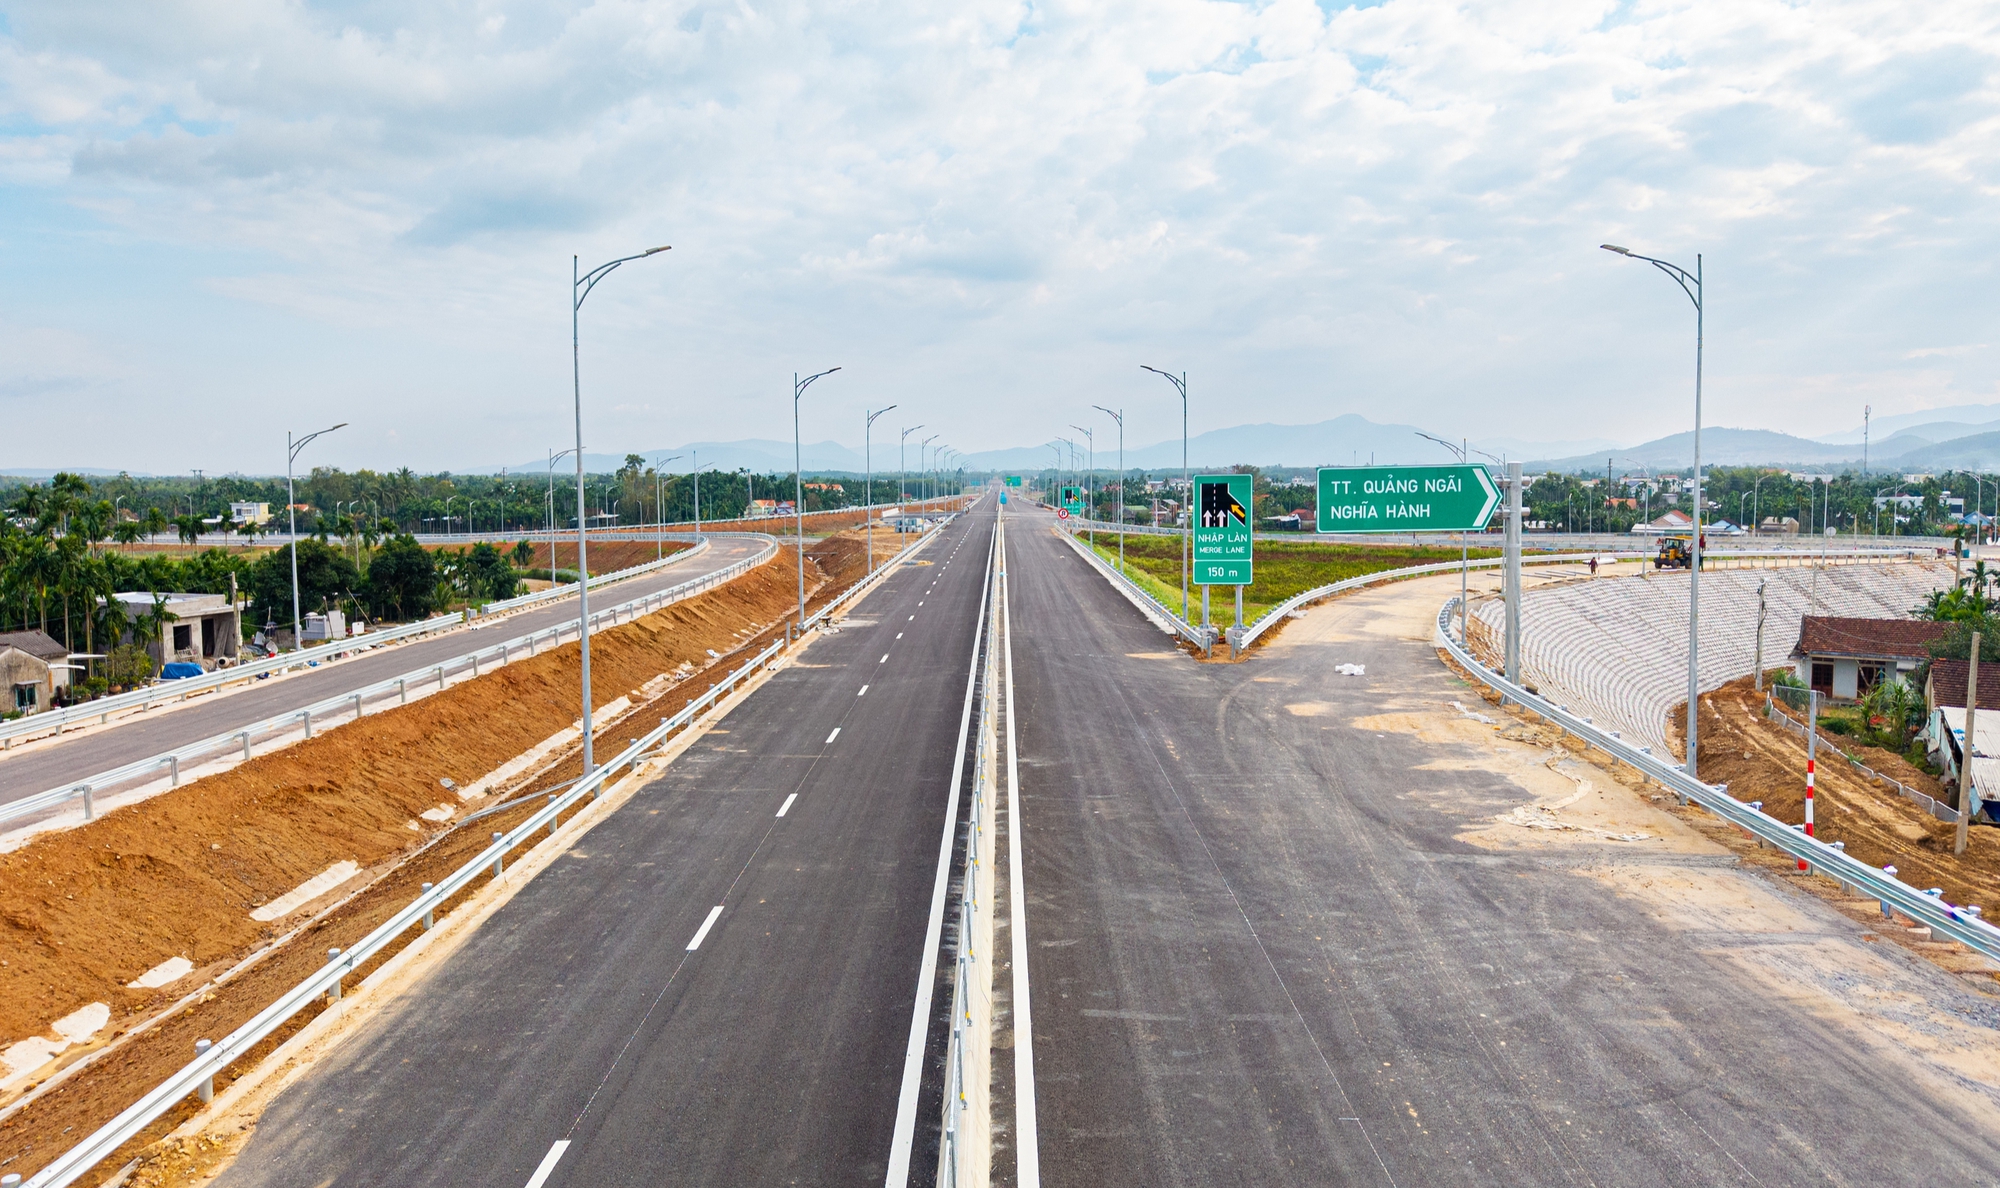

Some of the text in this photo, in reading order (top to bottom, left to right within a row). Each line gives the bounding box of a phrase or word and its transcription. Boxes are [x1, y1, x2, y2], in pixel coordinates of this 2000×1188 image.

[1331, 474, 1462, 495] TT. QUẢNG NGÃI
[1331, 500, 1431, 519] NGHĨA HÀNH
[1198, 531, 1248, 545] NHẬP LÀN
[1199, 546, 1245, 554] MERGE LANE
[1207, 566, 1238, 577] 150 m
